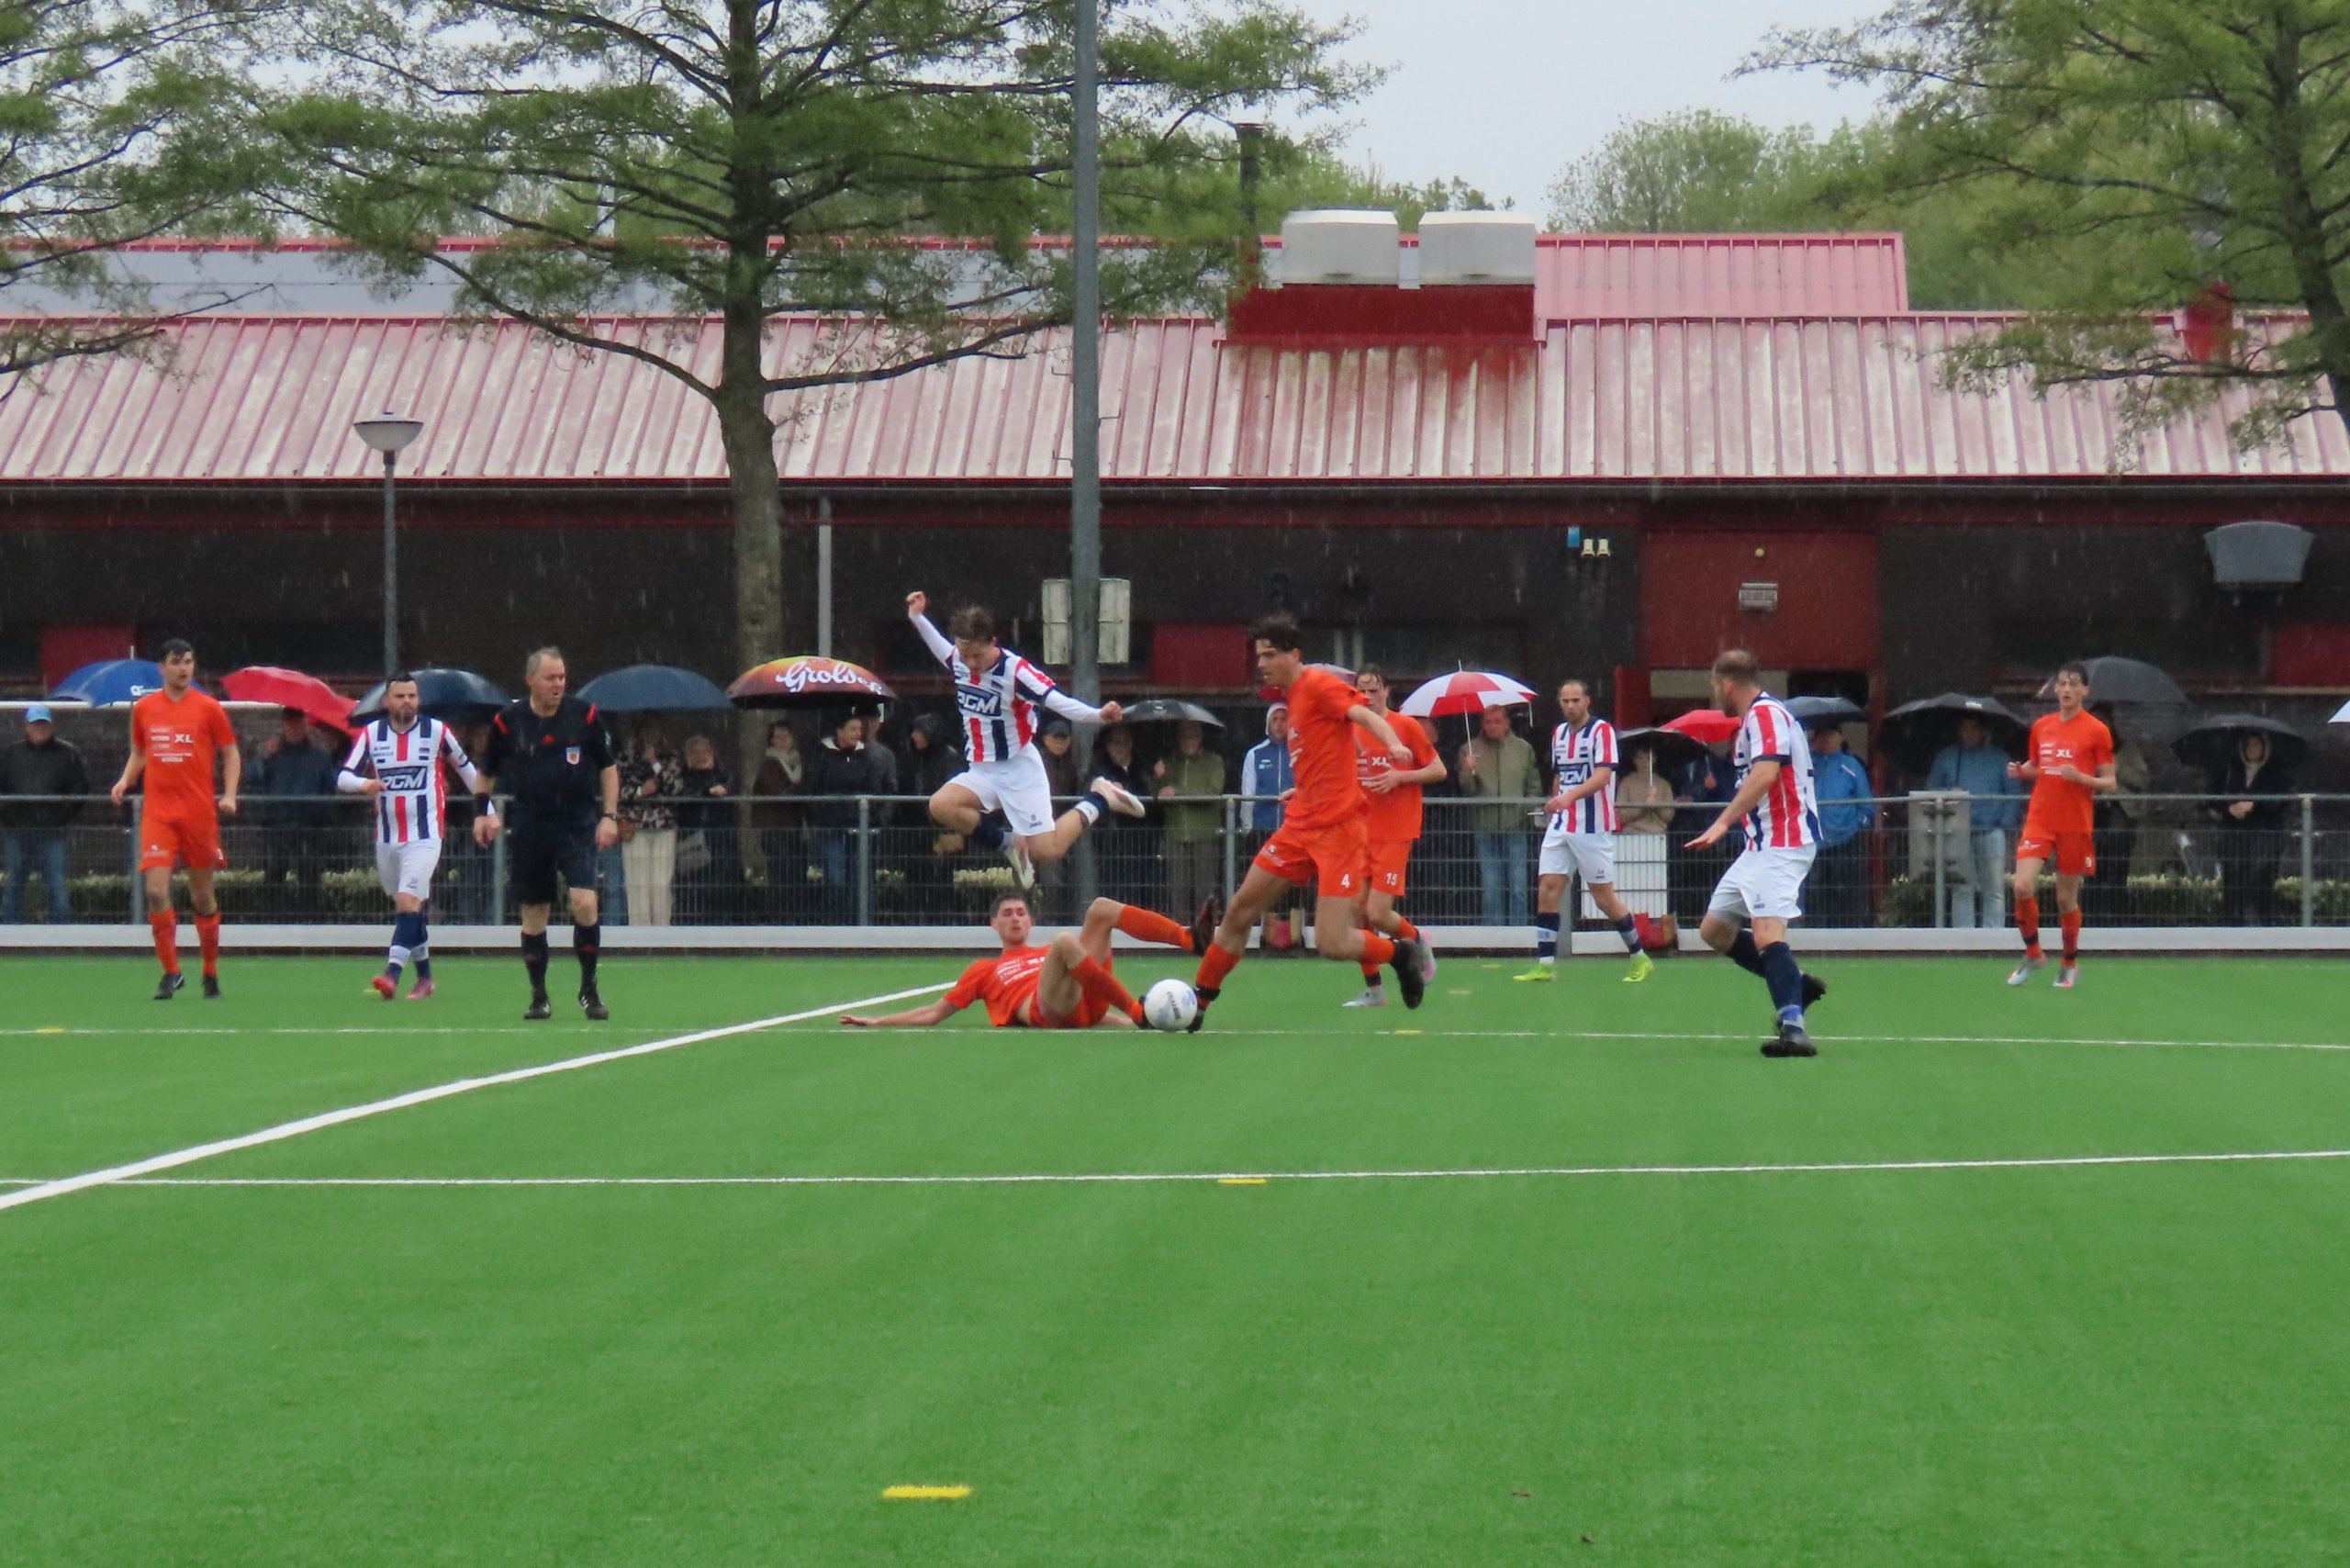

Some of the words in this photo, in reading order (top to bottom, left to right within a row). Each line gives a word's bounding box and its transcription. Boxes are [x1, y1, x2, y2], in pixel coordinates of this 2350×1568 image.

[174, 734, 193, 744] XL
[2056, 748, 2073, 758] XL
[1340, 873, 1351, 889] 4
[1385, 872, 1398, 887] 15
